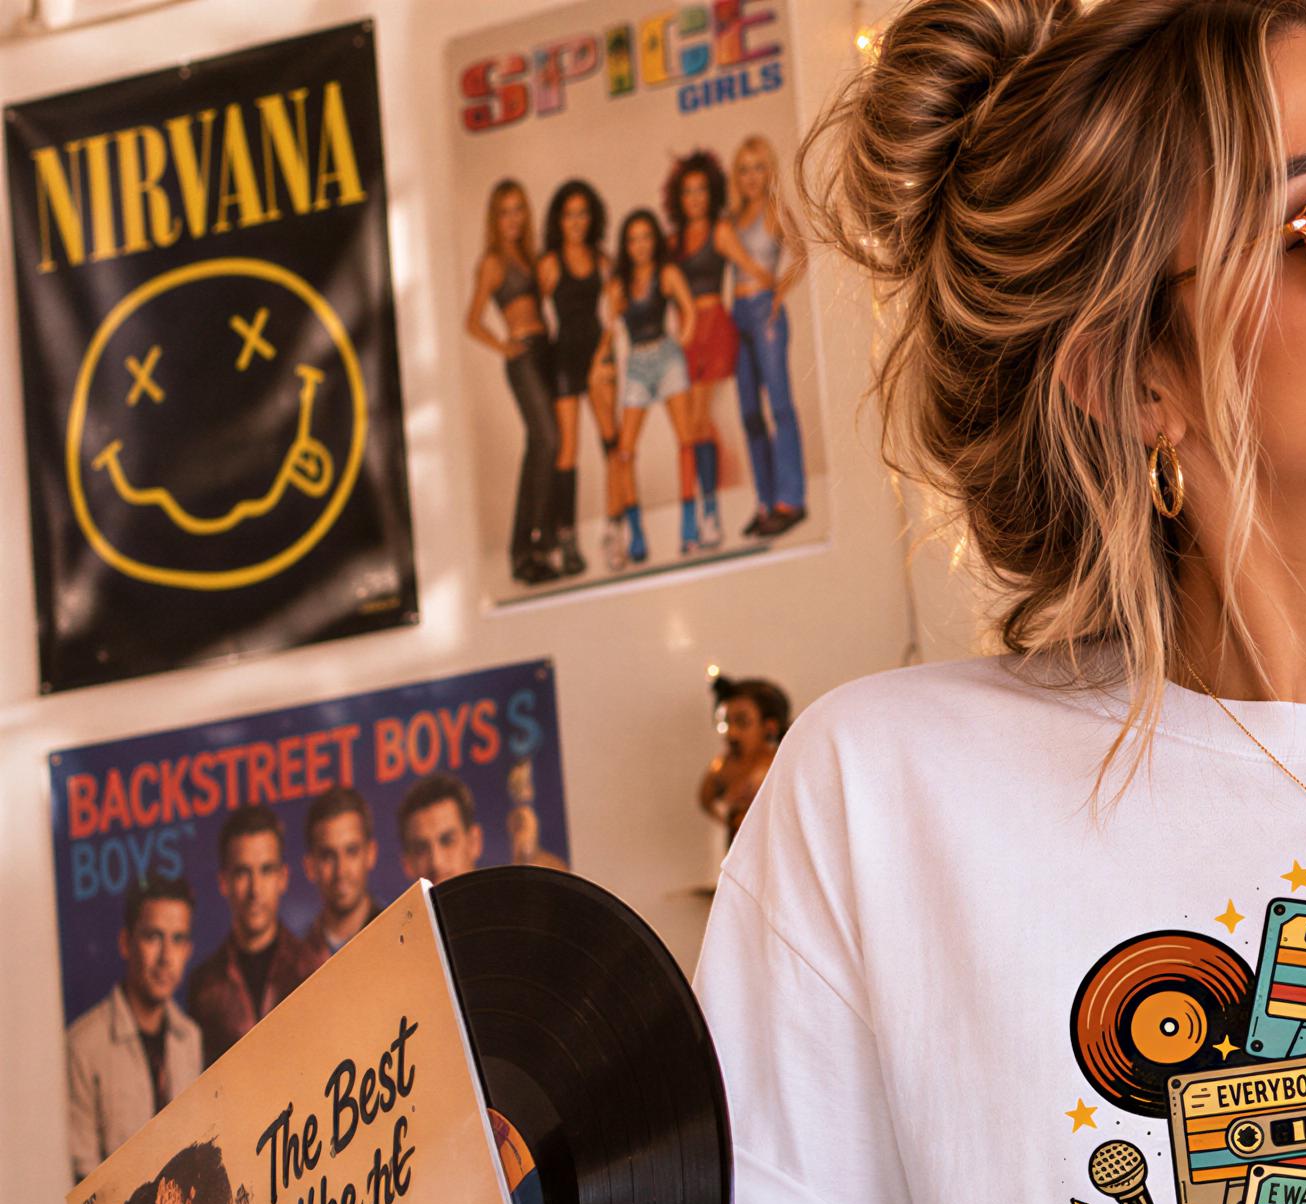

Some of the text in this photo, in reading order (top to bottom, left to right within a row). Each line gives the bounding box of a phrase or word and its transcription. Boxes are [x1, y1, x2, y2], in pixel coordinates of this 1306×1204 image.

[677, 61, 784, 114] GIRLS
[31, 80, 368, 276] NIRVANA
[68, 724, 363, 840] BACKSTREET
[374, 698, 501, 784] BOYS
[324, 1015, 419, 1159] Best
